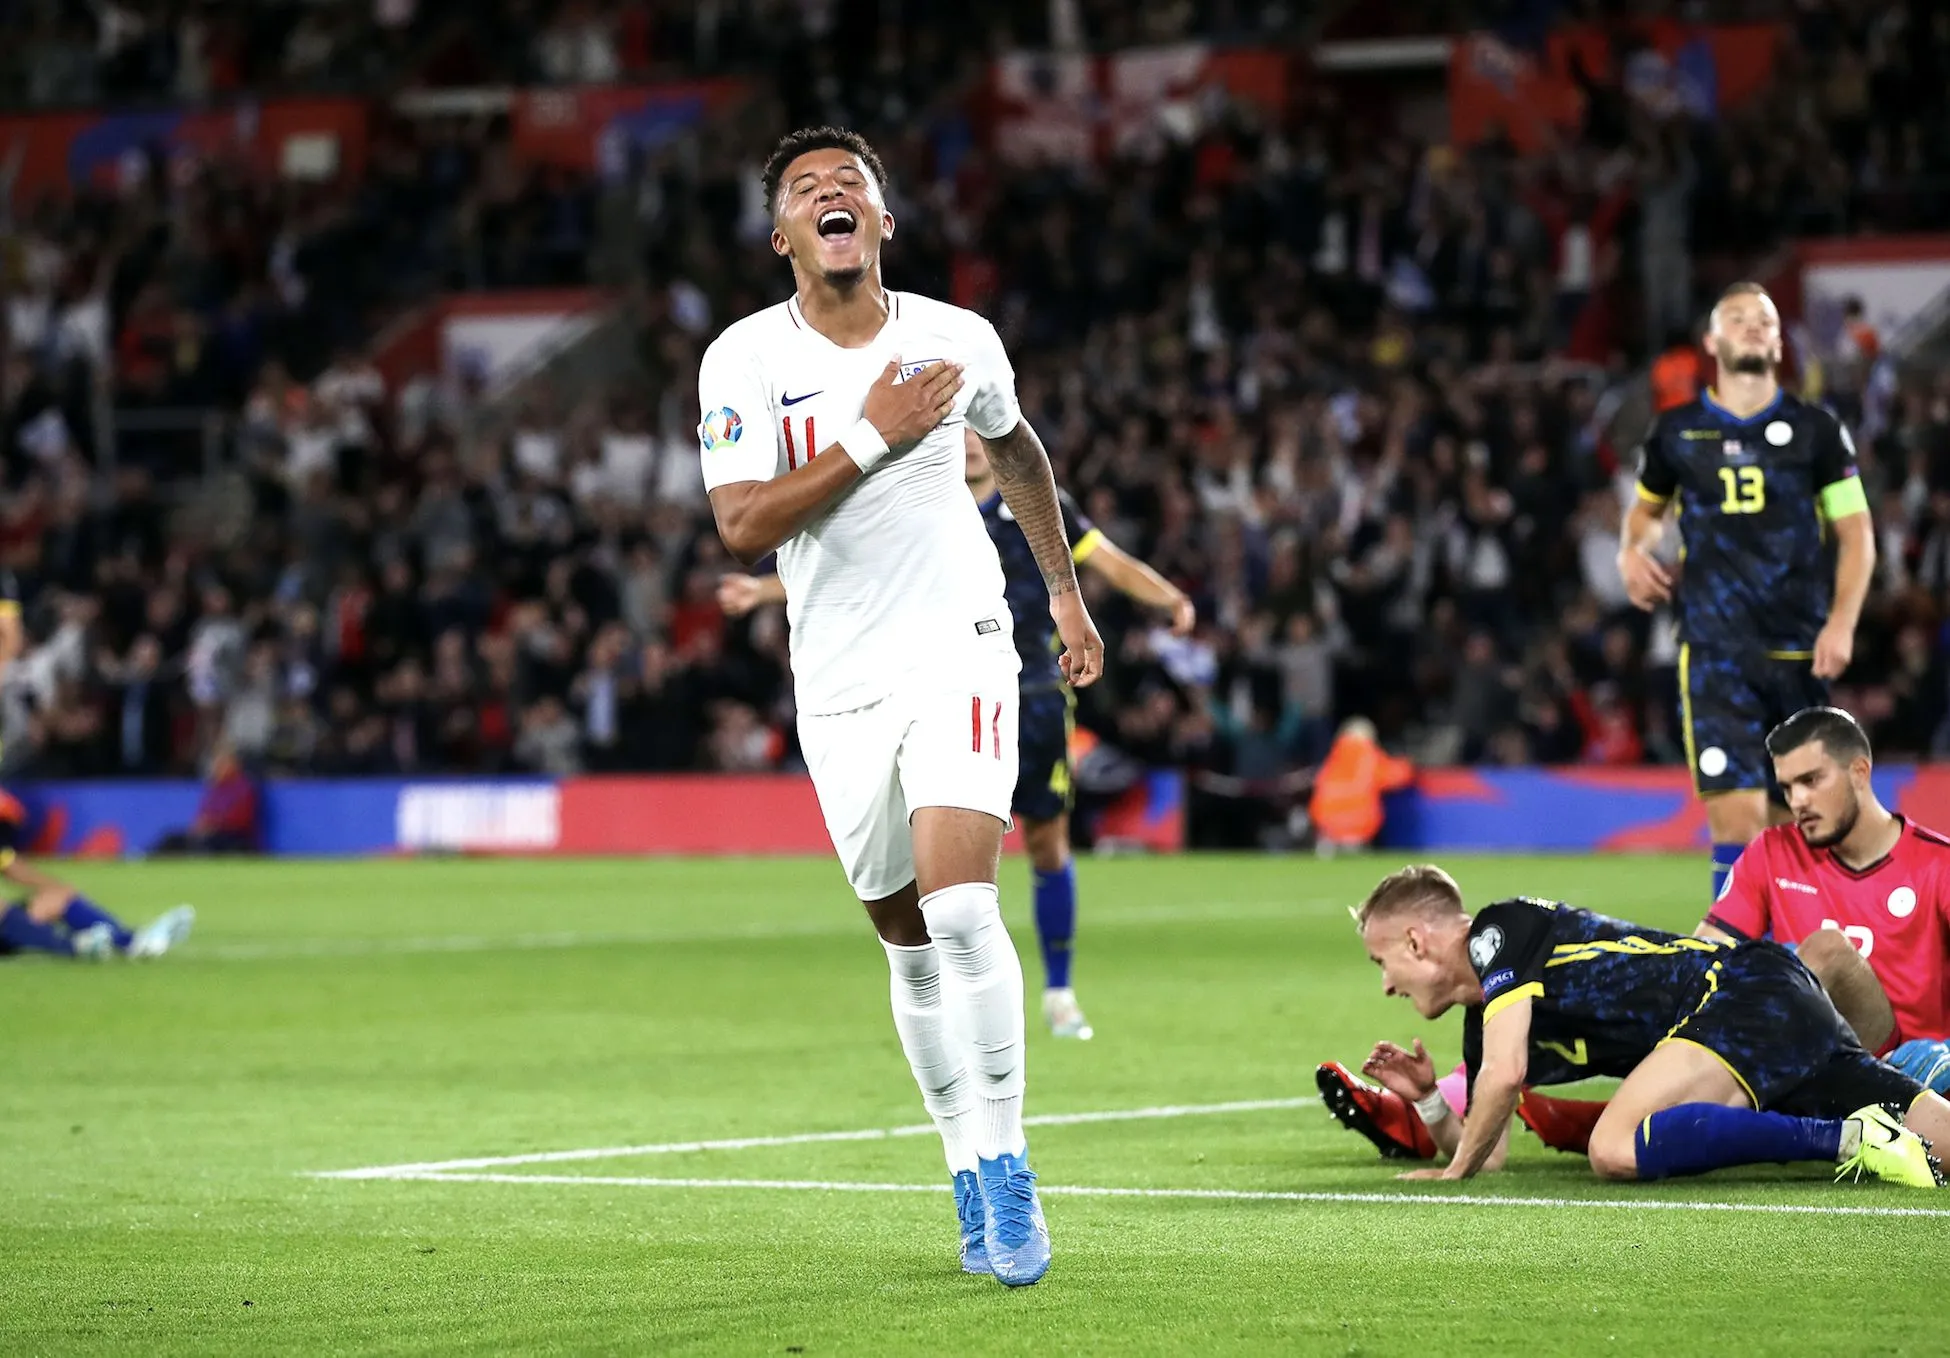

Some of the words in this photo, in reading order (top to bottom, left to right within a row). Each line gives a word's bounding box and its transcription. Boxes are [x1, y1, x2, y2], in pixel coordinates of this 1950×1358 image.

[783, 416, 816, 471] 11
[1718, 466, 1765, 514] 13
[972, 696, 1002, 760] 11
[1484, 969, 1516, 993] SPECT
